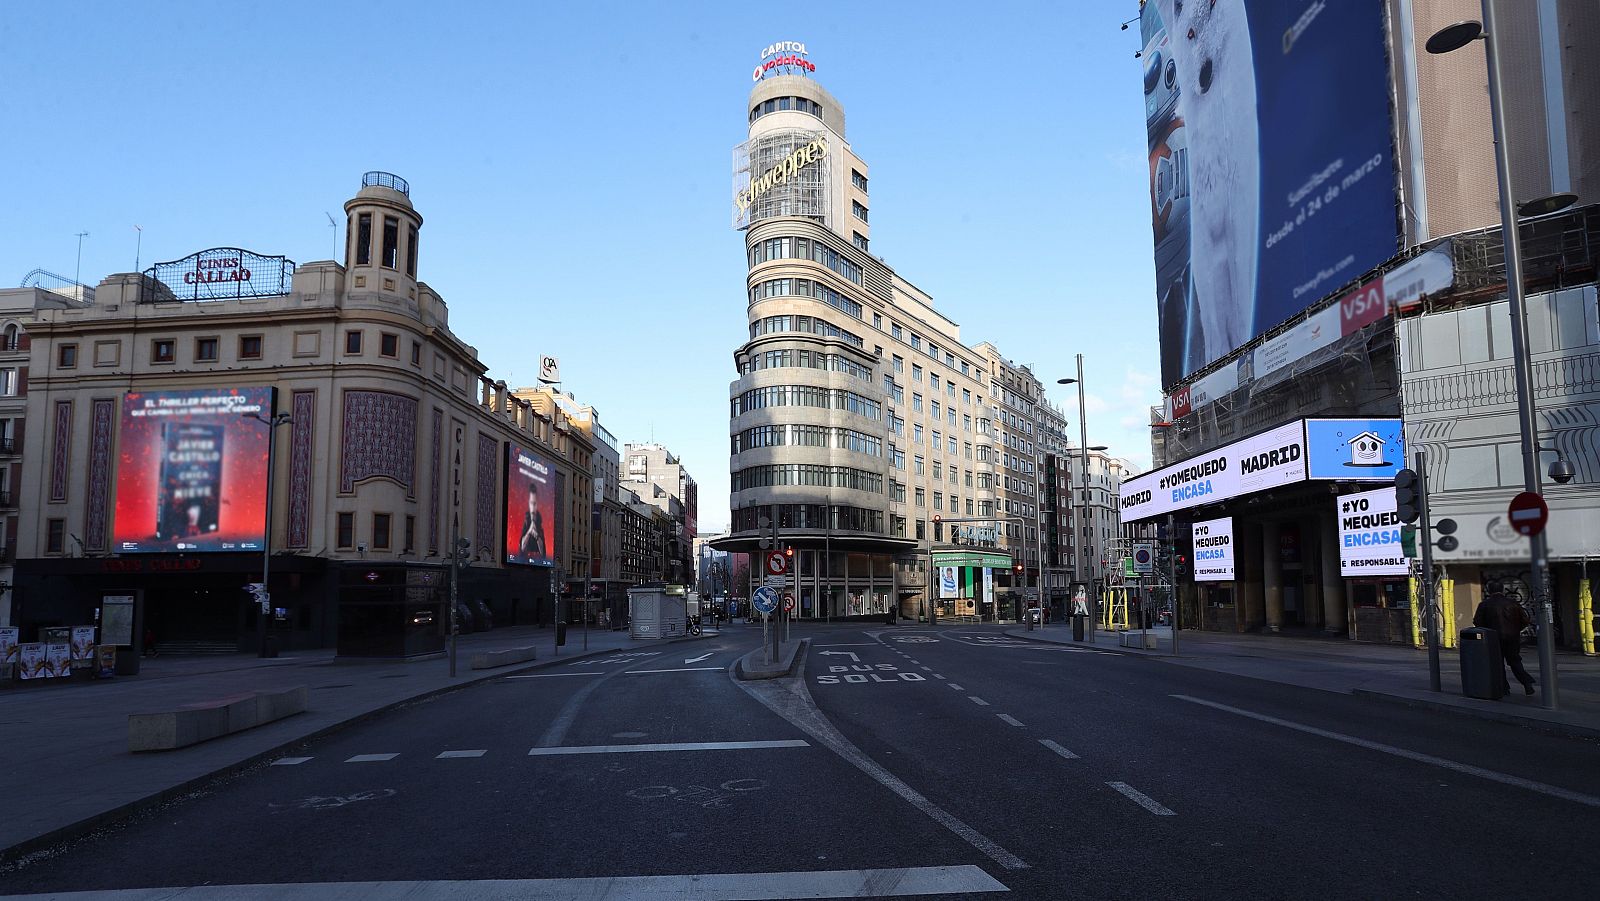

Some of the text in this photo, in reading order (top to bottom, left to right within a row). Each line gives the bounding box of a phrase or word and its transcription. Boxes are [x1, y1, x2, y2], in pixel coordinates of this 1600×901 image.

[761, 41, 808, 60] CAPITOL
[763, 55, 816, 74] vodafone
[735, 135, 828, 218] Schweppes
[1266, 153, 1382, 248] desde el 24 de marzo
[198, 257, 239, 270] CINES
[1293, 254, 1355, 299] DisneyPlus.com
[1343, 288, 1382, 320] VSA
[159, 398, 199, 407] THRILLER
[200, 395, 246, 406] PERFECTO
[1173, 391, 1190, 410] VSA
[177, 440, 215, 450] JAVIER
[169, 451, 220, 462] CASTILLO
[1241, 443, 1301, 475] MADRID
[453, 428, 462, 528] CALLA
[1159, 457, 1227, 490] #YOMEQUEDO
[1121, 490, 1152, 509] MADRID
[1171, 480, 1213, 503] ENCASA
[1342, 498, 1369, 513] #YO
[1343, 511, 1401, 531] MEQUED
[1195, 525, 1209, 536] #YO
[1343, 530, 1402, 547] ENCASA
[1195, 535, 1230, 548] MEQUEDO
[1195, 549, 1225, 560] ENCASA
[1350, 557, 1406, 567] RESPONSABLE
[1462, 550, 1484, 558] THE
[1488, 549, 1520, 557] BODY
[1199, 567, 1227, 575] RESPONSABLE
[828, 663, 898, 673] BUS
[816, 672, 927, 684] SOLO
